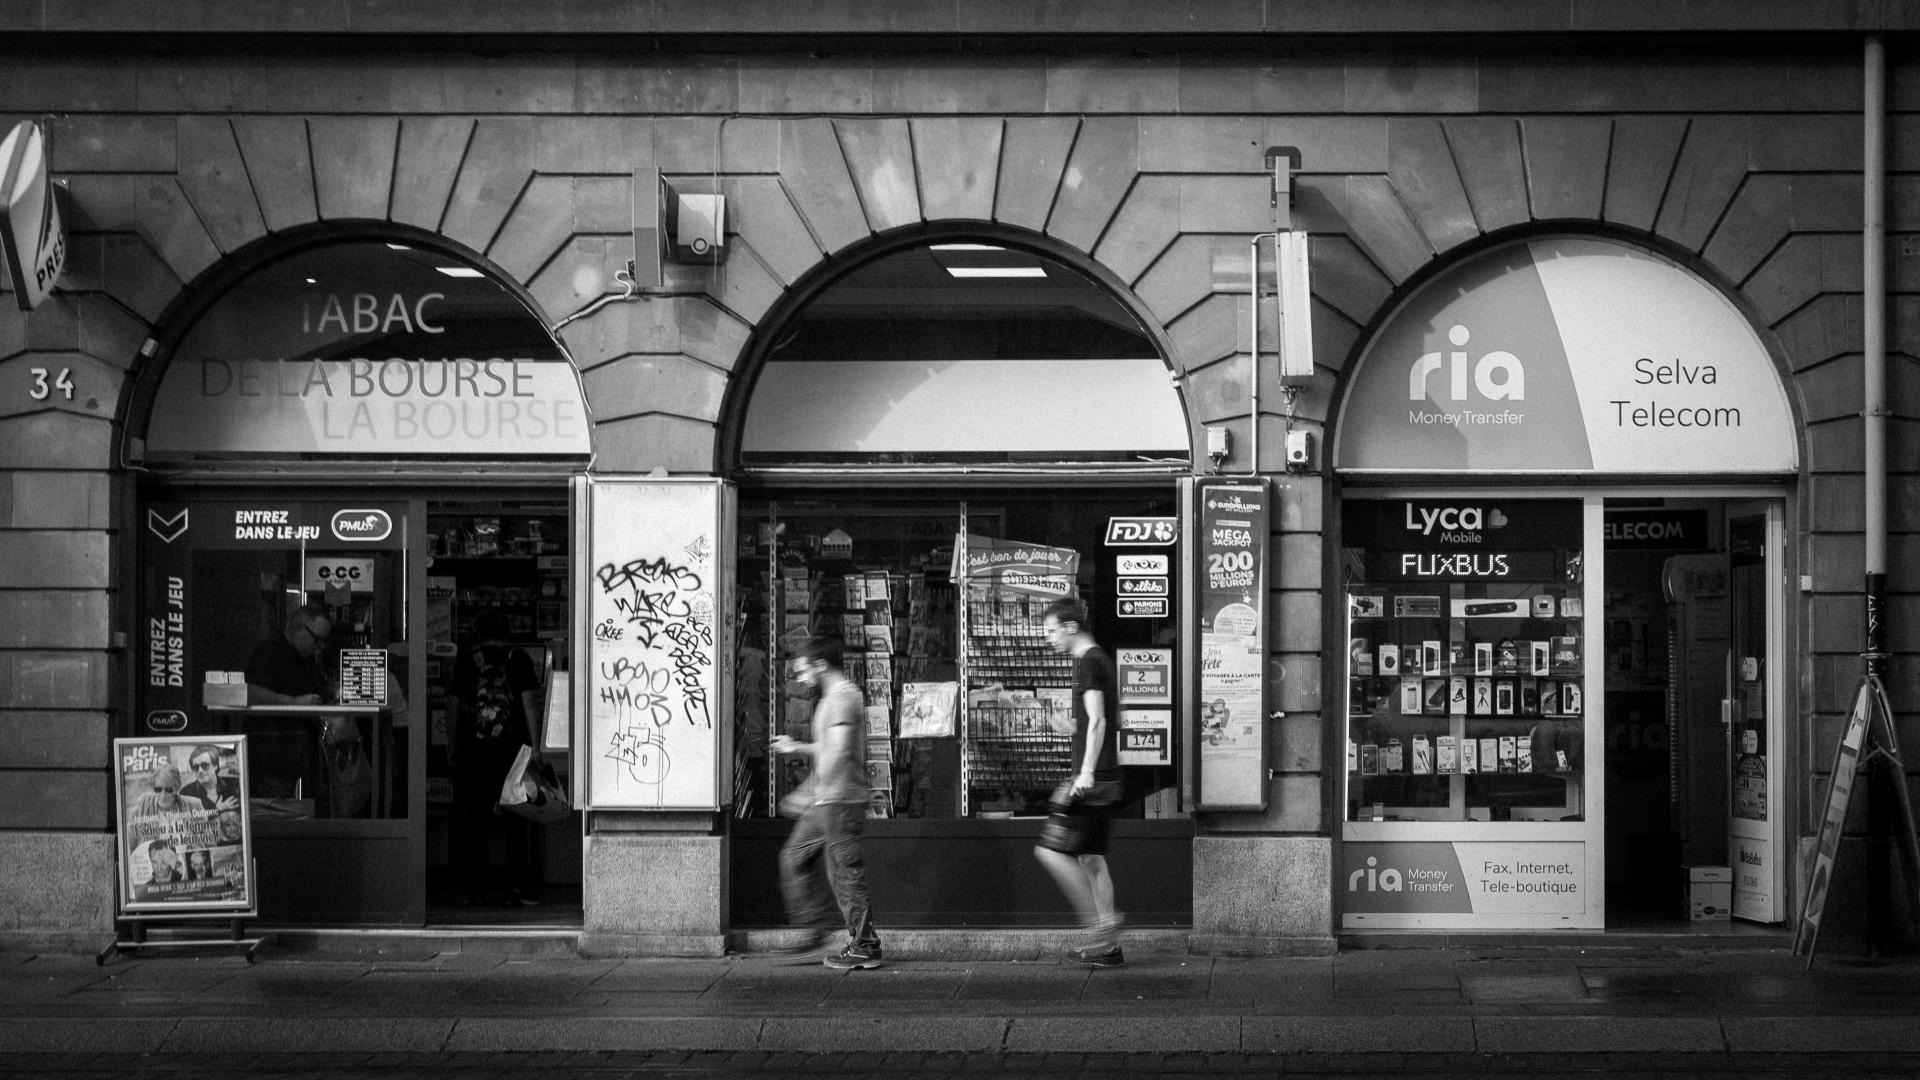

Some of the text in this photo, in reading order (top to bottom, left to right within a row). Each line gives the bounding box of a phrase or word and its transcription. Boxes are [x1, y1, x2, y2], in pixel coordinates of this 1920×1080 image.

[302, 293, 446, 334] TABAC
[1410, 324, 1525, 401] ria
[202, 359, 534, 397] DE LA BOURSE
[1634, 358, 1717, 385] Selva
[29, 367, 75, 400] 34
[1410, 410, 1525, 427] Money Transfer
[1610, 400, 1741, 428] Telecom
[235, 511, 288, 523] ENTREZ
[1406, 503, 1482, 535] Lyca
[235, 526, 320, 539] DANS LE JEU
[1111, 522, 1153, 540] FDJ
[1441, 532, 1482, 543] Mobile
[1213, 539, 1251, 547] JACKPOT
[1208, 551, 1254, 573] 200
[1402, 554, 1509, 575] FLIXBUS
[1210, 570, 1254, 581] MILLIONS
[1211, 578, 1253, 589] D'EUROS
[168, 576, 183, 688] DANS LE JEU
[150, 617, 166, 688] ENTREZ
[1138, 671, 1146, 682] 2
[1133, 735, 1155, 746] 174
[132, 745, 154, 760] ICI
[124, 753, 168, 772] Paris
[1349, 856, 1403, 892] ria
[1408, 868, 1448, 881] Money
[1484, 861, 1573, 875] Fax, Internet,
[1408, 881, 1454, 892] Transfer
[1480, 880, 1577, 894] Tele-boutique
